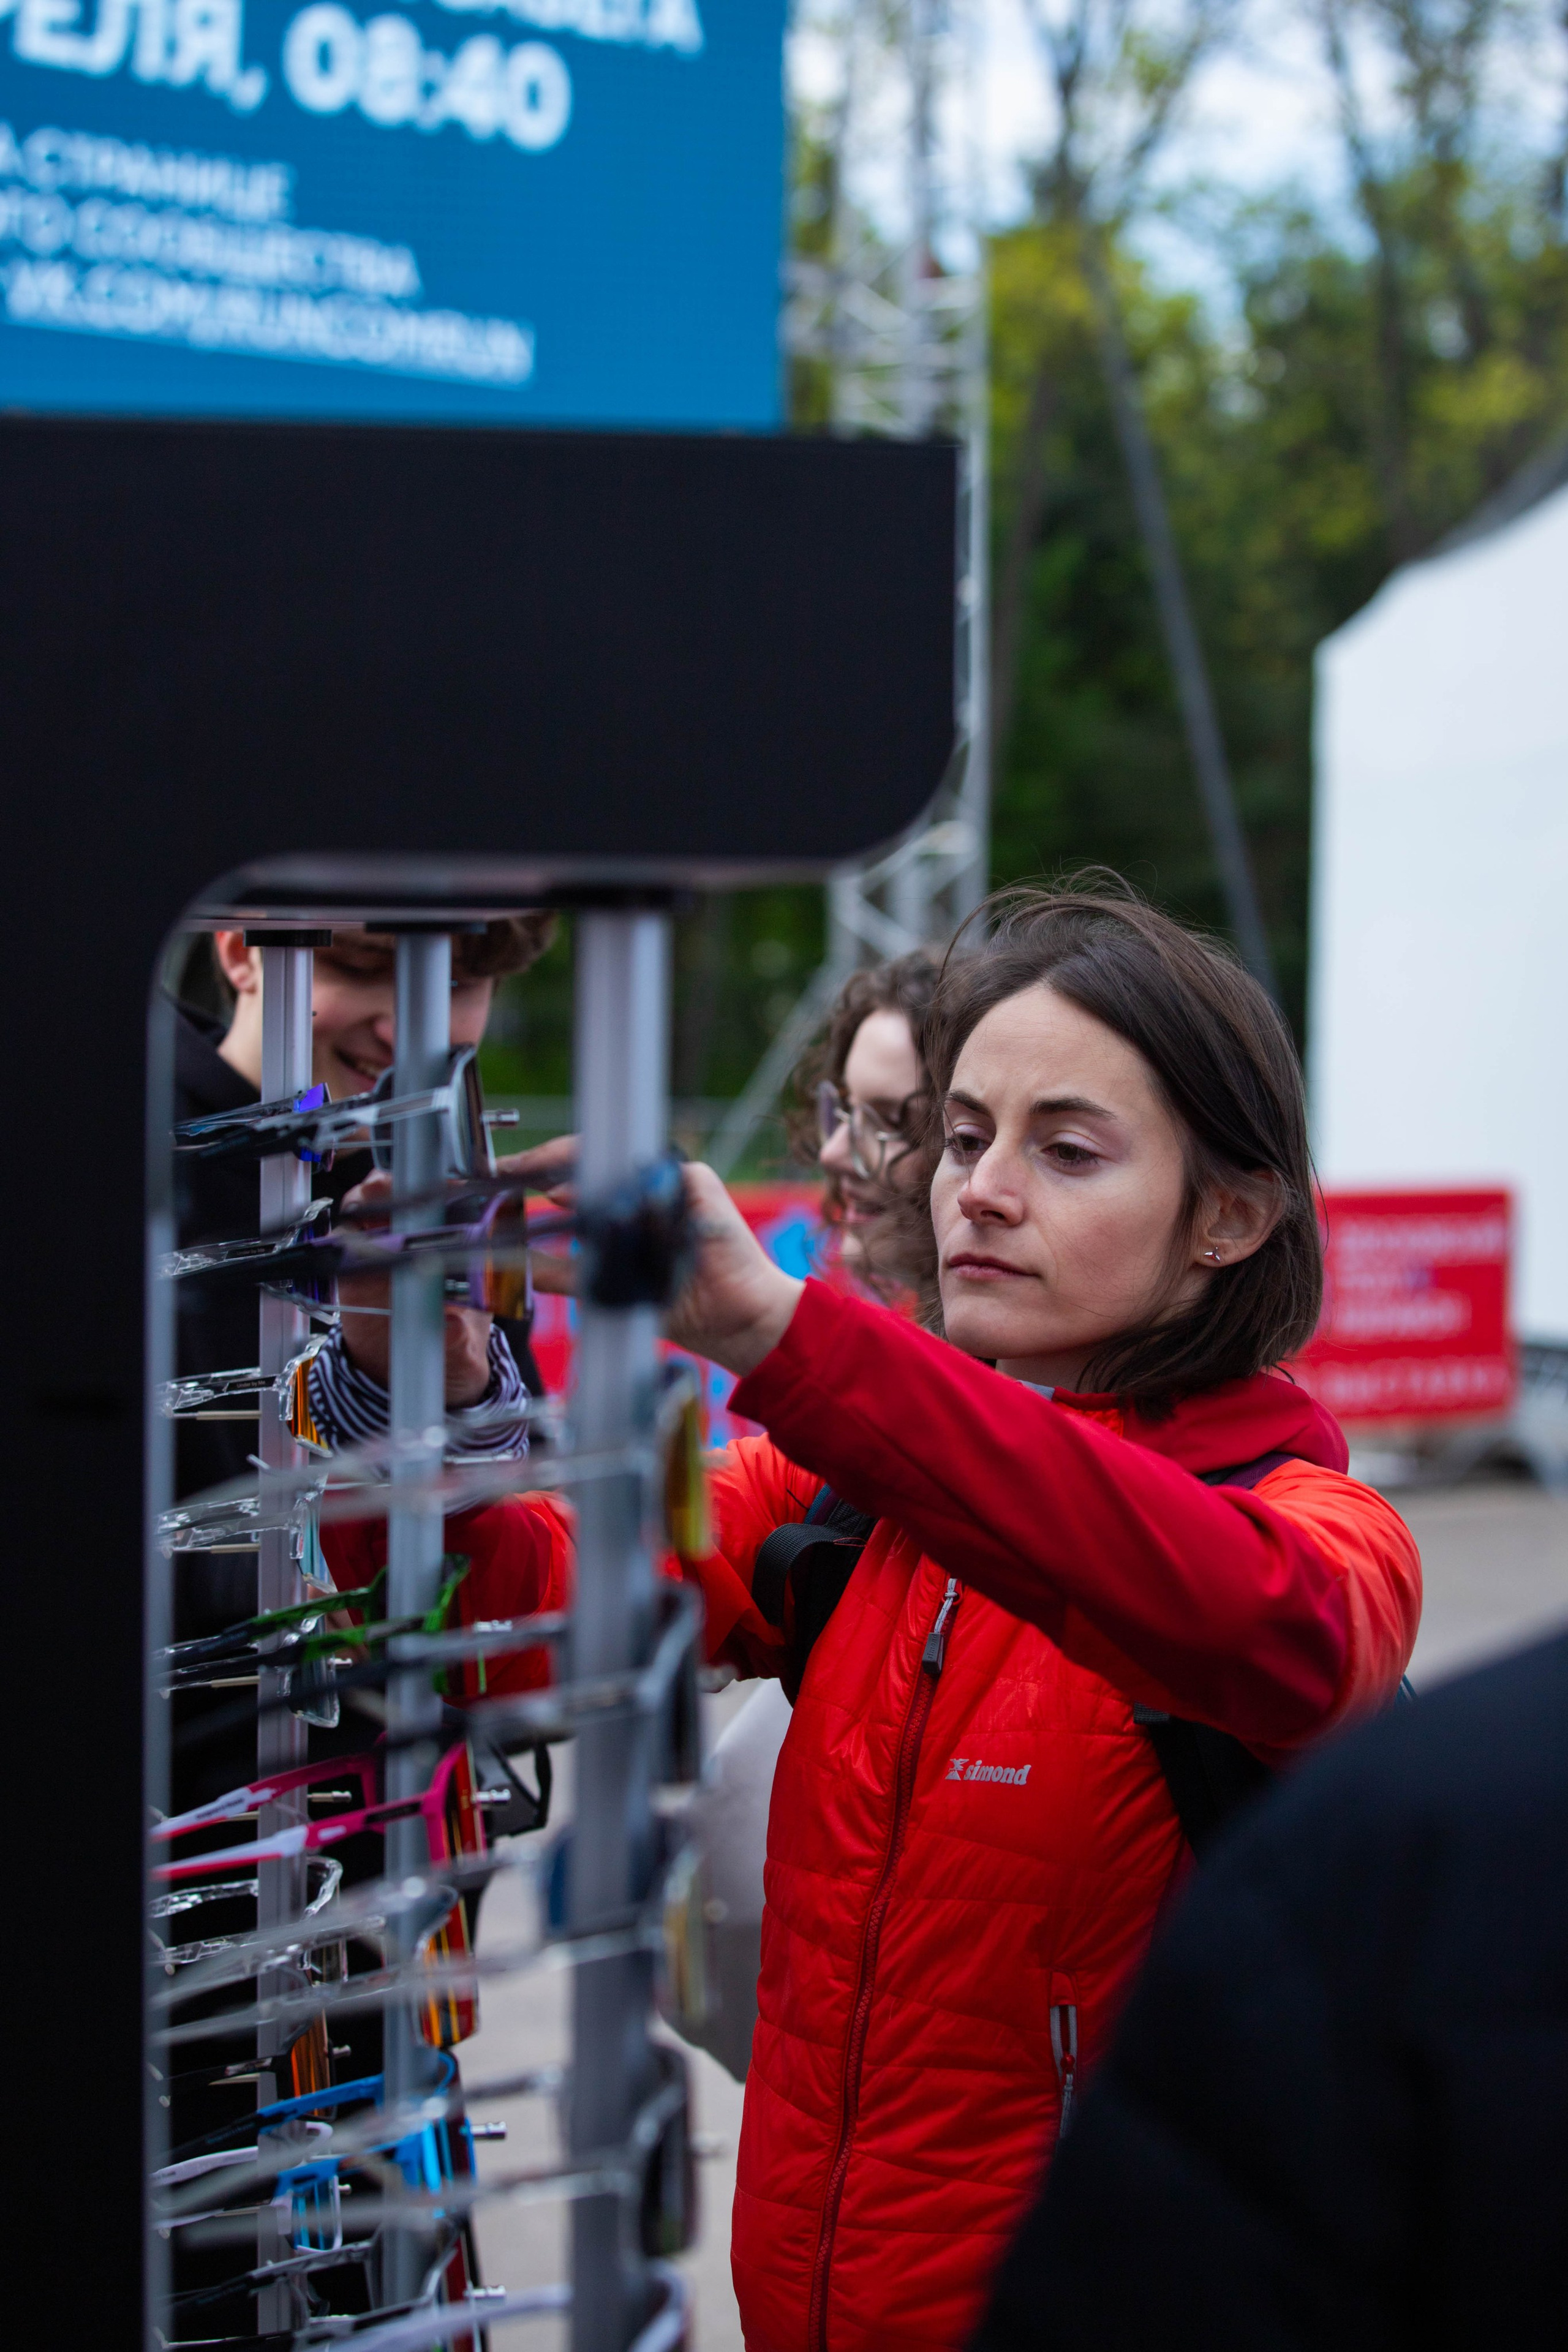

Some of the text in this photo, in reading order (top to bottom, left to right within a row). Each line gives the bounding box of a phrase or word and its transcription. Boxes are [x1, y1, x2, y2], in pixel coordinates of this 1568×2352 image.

[0, 0, 268, 114] ЕЛЯ,
[282, 1, 573, 152] 08:40
[963, 1760, 1031, 1785] simond
